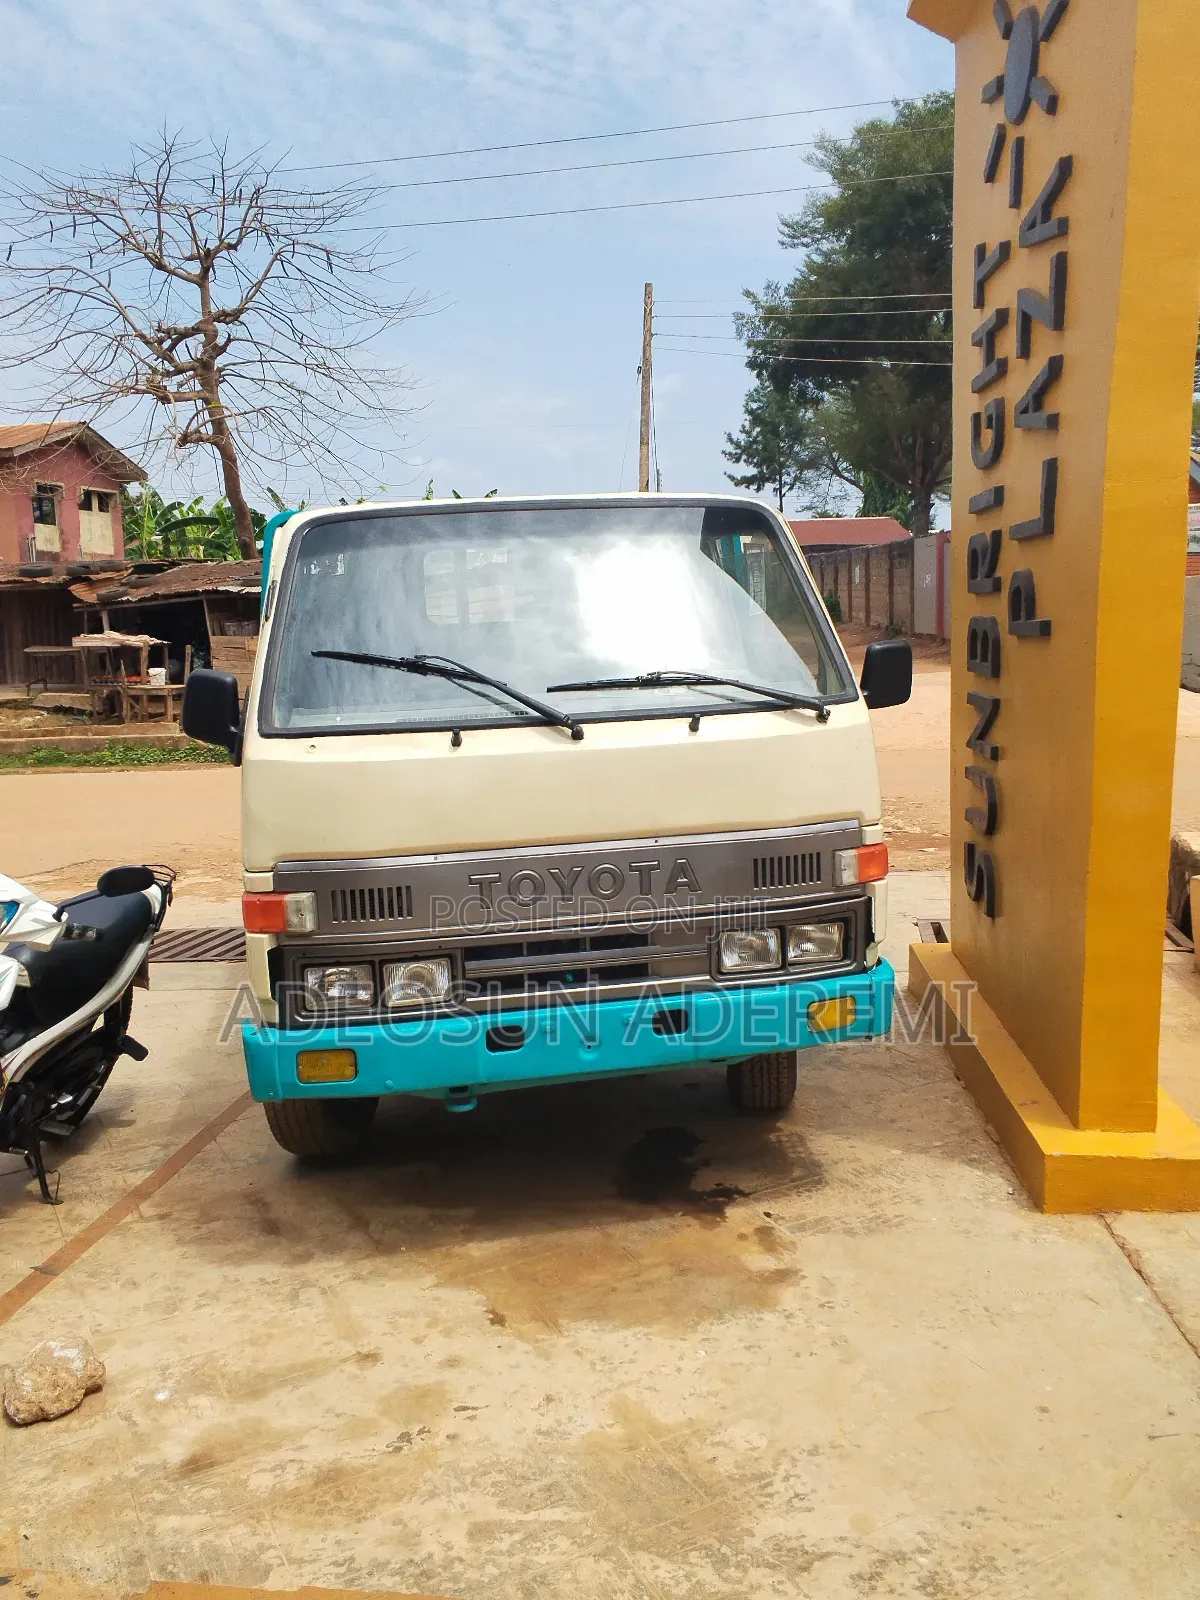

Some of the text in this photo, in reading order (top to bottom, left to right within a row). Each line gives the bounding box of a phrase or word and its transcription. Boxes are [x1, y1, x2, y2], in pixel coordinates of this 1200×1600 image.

[963, 240, 1011, 918] SUNBRIGHT
[1008, 154, 1073, 637] PLAZA
[468, 858, 702, 911] TOYOTA
